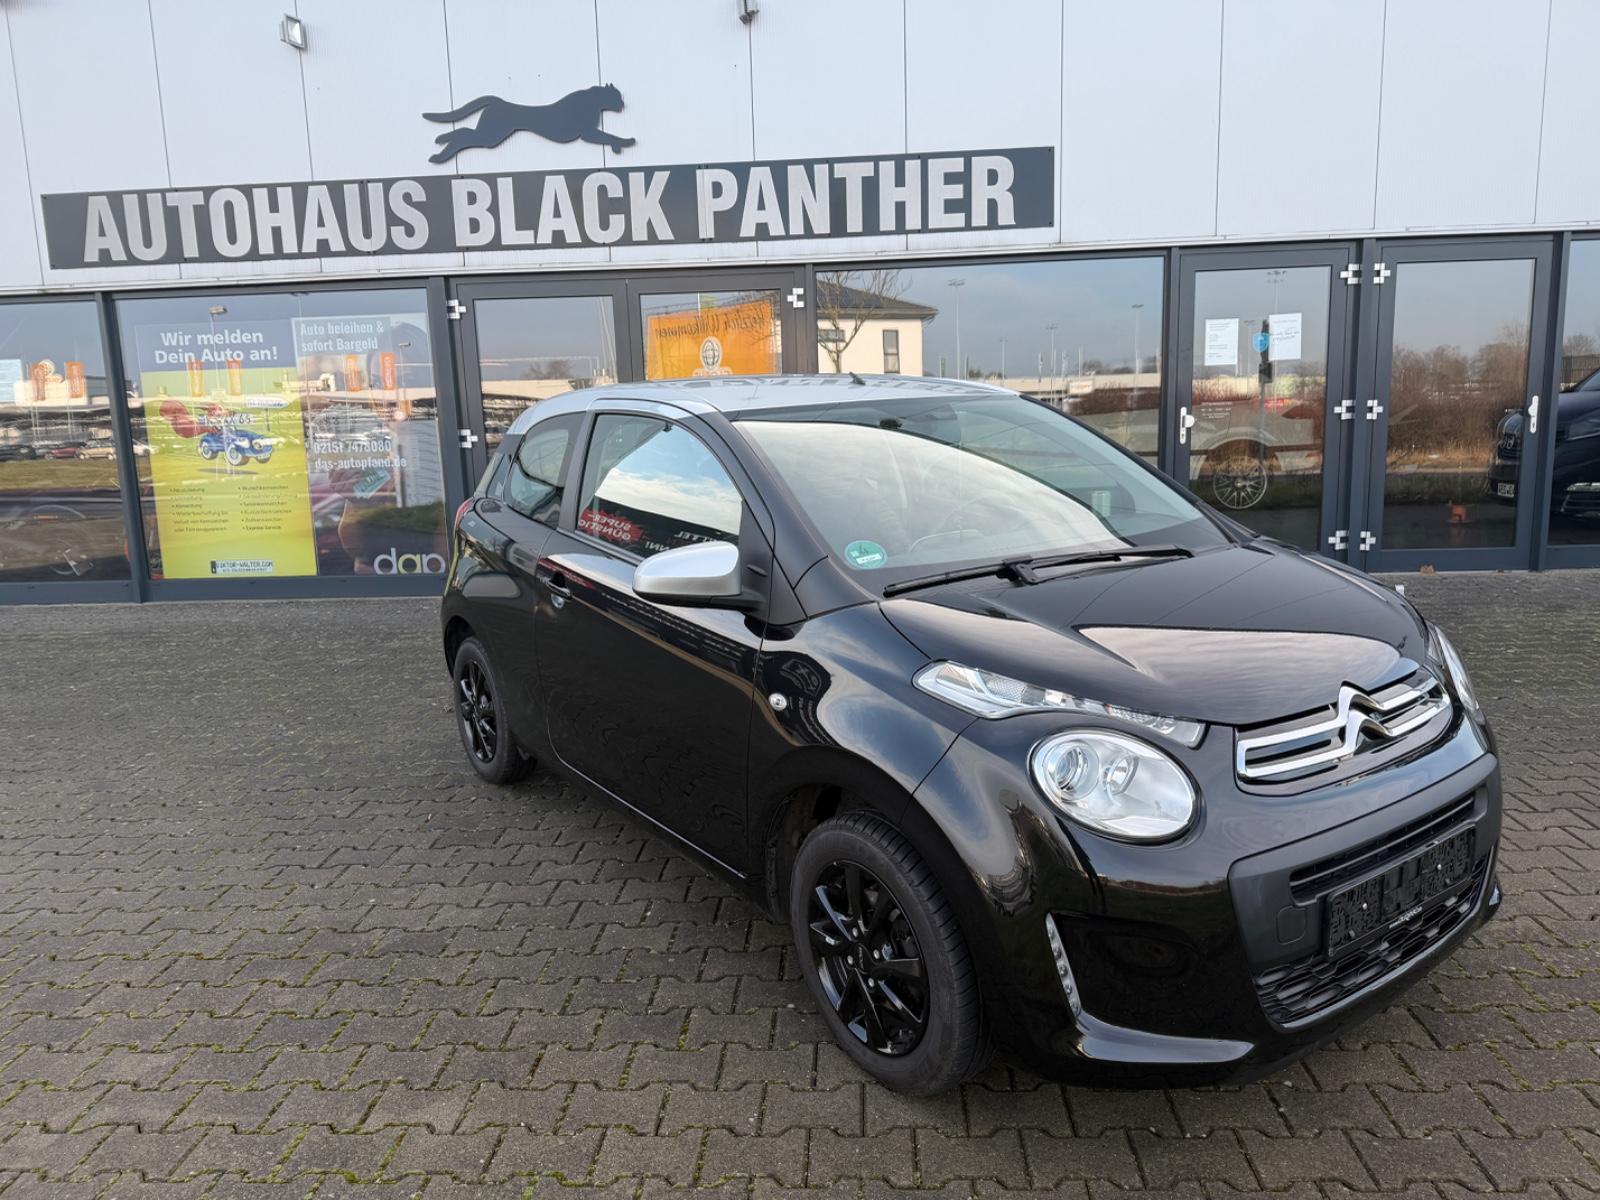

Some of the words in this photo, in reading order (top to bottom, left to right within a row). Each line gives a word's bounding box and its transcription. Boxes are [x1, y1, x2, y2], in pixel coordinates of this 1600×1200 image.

[83, 179, 429, 263] AUTOHAUS
[450, 170, 676, 248] BLACK
[696, 155, 1017, 239] PANTHER
[300, 323, 325, 336] Auto
[327, 321, 373, 335] beleihen
[375, 320, 384, 333] &
[160, 331, 192, 346] Wir
[197, 329, 264, 345] melden
[301, 339, 334, 352] sofort
[336, 337, 379, 352] Bargeld
[154, 348, 196, 364] Dein
[201, 347, 244, 362] Auto
[249, 345, 279, 361] an!
